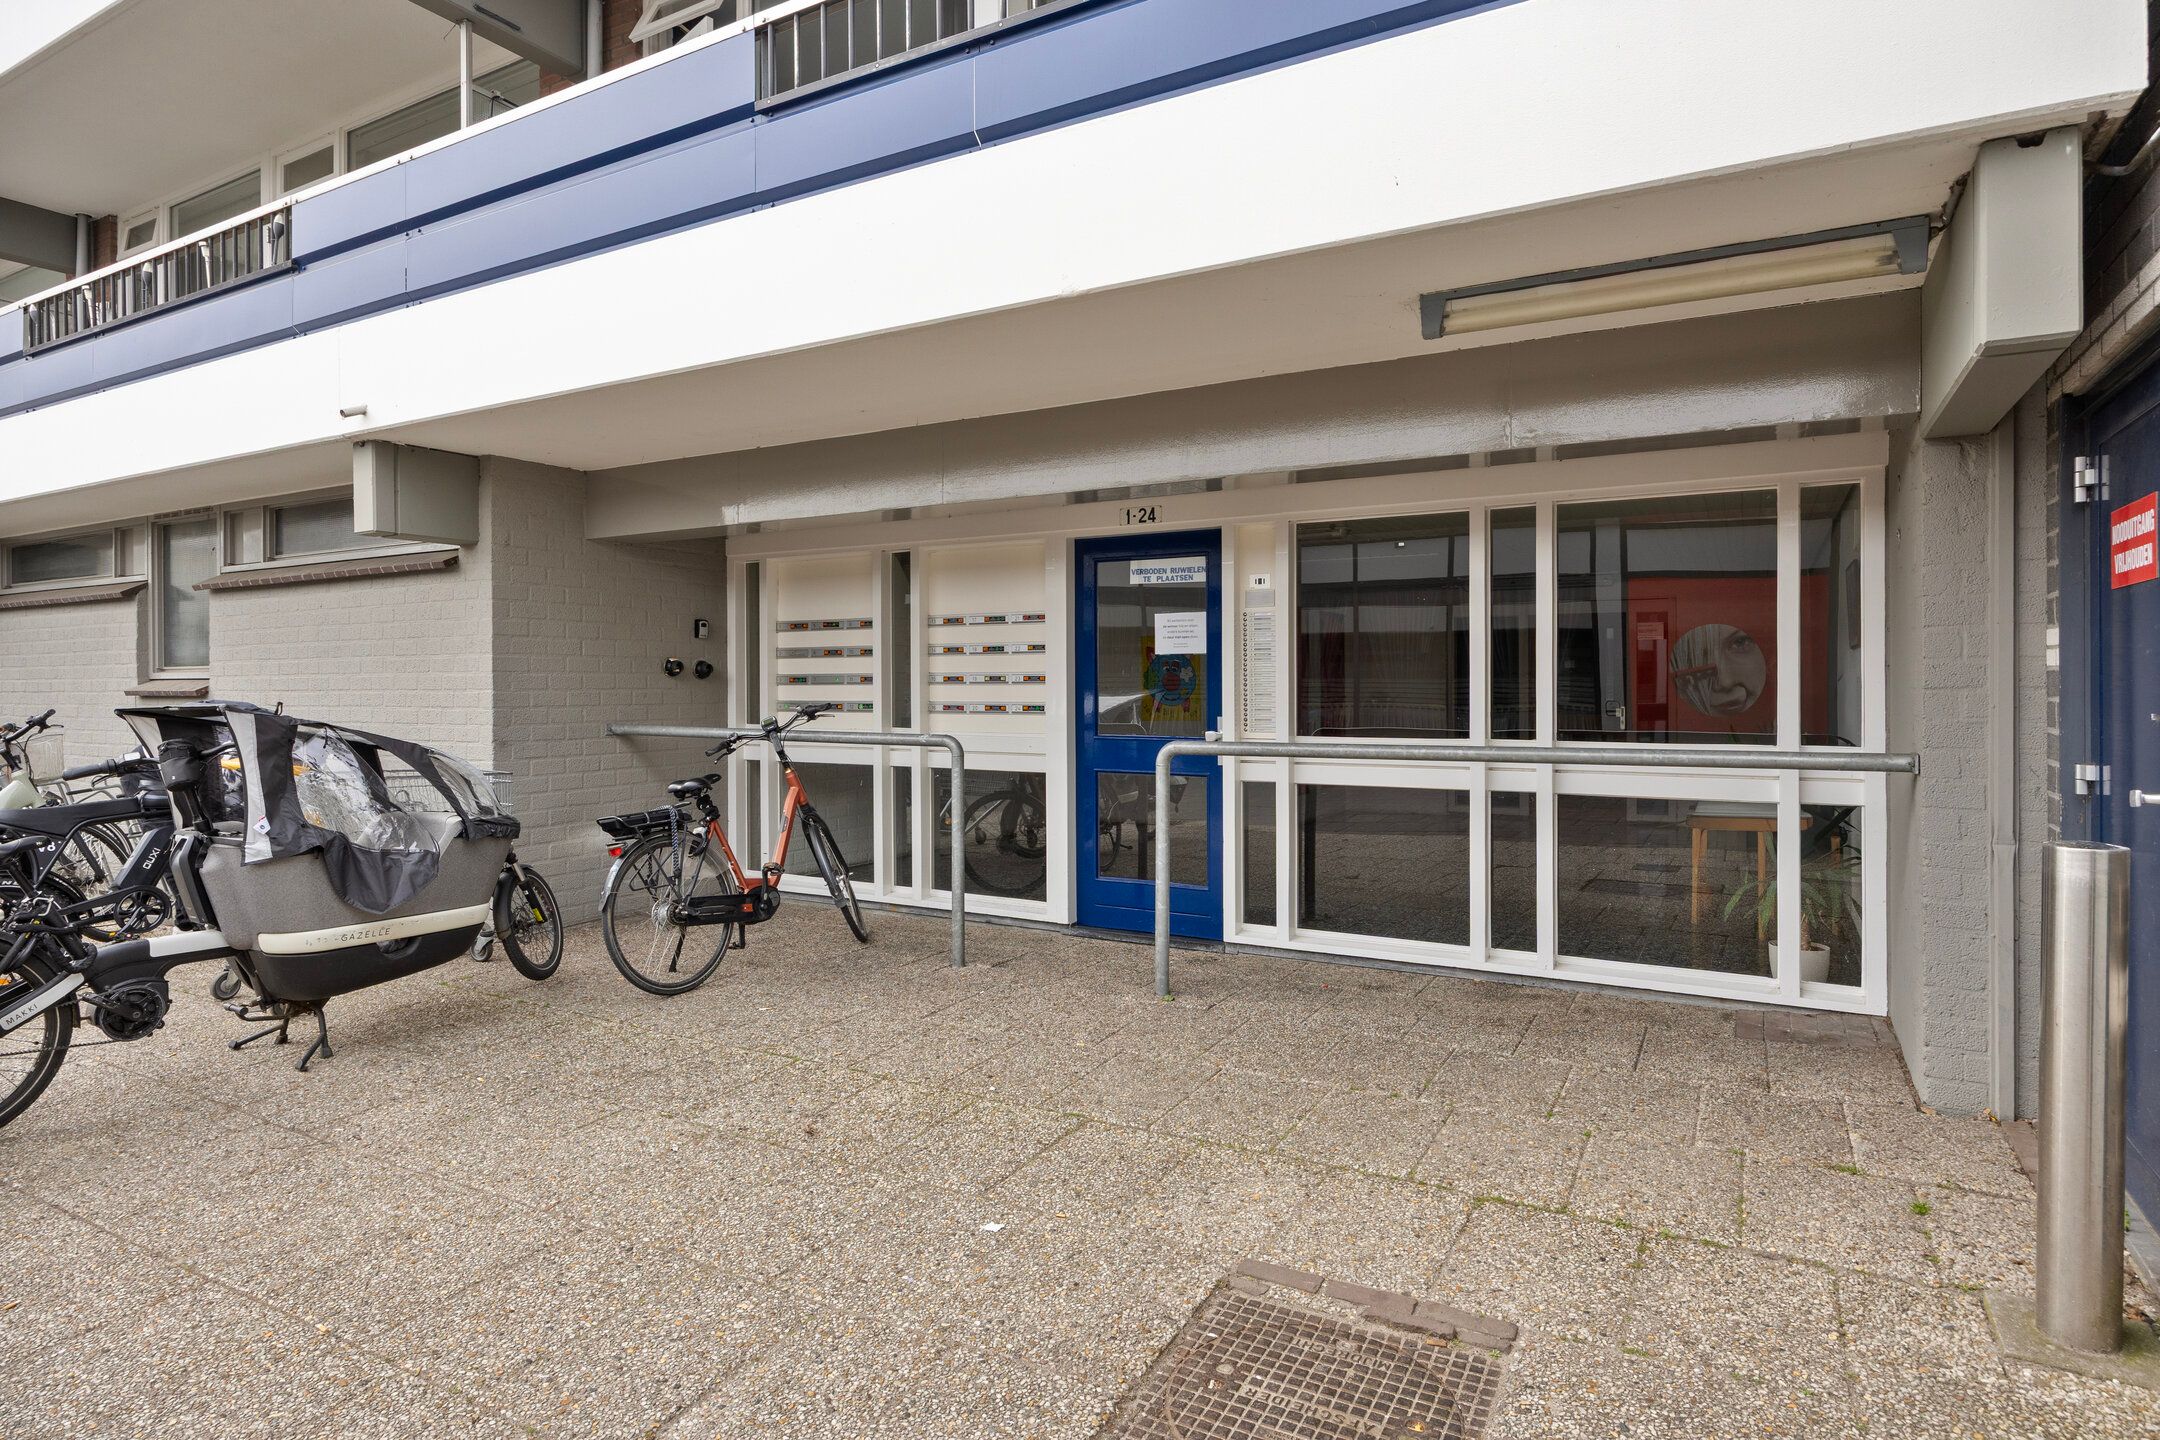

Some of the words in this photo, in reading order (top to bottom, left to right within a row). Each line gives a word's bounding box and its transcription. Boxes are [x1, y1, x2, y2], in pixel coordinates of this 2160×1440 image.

[1126, 507, 1156, 524] 1-24
[2112, 508, 2155, 546] NOODUITGANG
[2114, 542, 2153, 574] VRIJHOUDEN
[1131, 567, 1167, 575] VERBODEN
[1170, 566, 1206, 574] RIJWIELEN
[1156, 574, 1194, 582] PLAATSEN
[341, 927, 391, 942] GAZELLE
[5, 1003, 38, 1025] MAKKI
